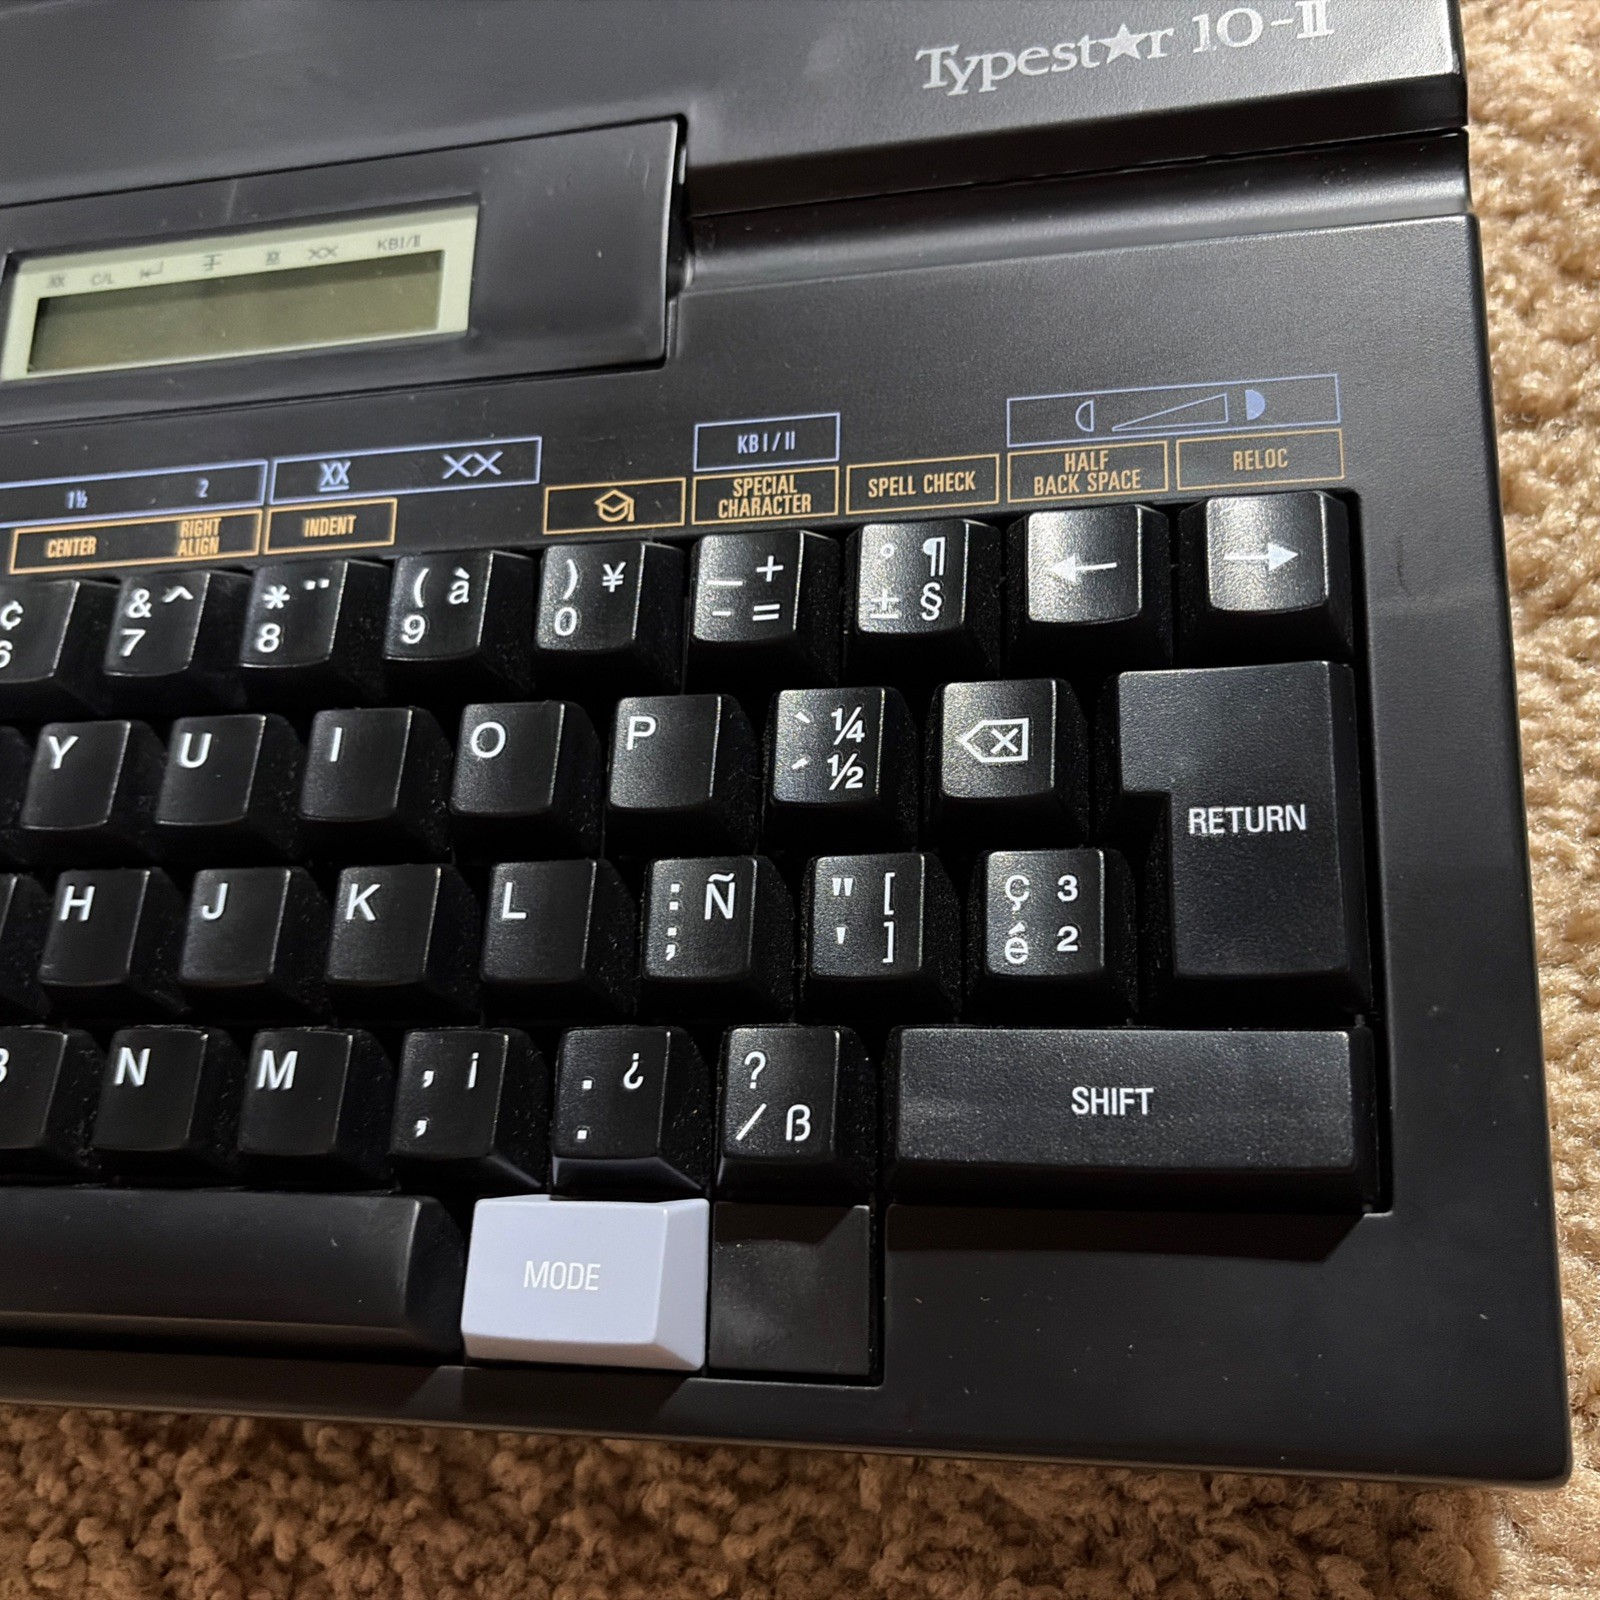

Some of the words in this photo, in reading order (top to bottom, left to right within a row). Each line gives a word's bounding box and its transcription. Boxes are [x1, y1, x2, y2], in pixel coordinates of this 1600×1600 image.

[1064, 450, 1110, 474] HALF
[1232, 447, 1290, 472] RELOC
[732, 474, 798, 498] SPECIAL
[867, 475, 917, 498] SPELL
[923, 470, 977, 494] CHECK
[1033, 474, 1081, 496] BACK
[1087, 468, 1142, 493] SPACE
[718, 493, 812, 519] CHARACTER
[177, 517, 222, 539] RIGHT
[303, 515, 357, 538] INDENT
[46, 536, 97, 558] CENTER
[176, 535, 220, 557] ALIGN
[602, 561, 628, 593] ¥
[756, 556, 784, 581] +
[126, 587, 154, 619] &
[412, 568, 429, 608] (
[919, 581, 944, 622] §
[751, 603, 781, 622] =
[119, 627, 147, 658] 7
[256, 623, 283, 655] 8
[401, 614, 427, 645] 9
[625, 714, 657, 751] P
[48, 734, 79, 770] Y
[178, 731, 213, 769] U
[1188, 803, 1308, 837] RETURN
[59, 884, 95, 922] H
[201, 882, 229, 921] J
[344, 883, 381, 922] K
[500, 881, 528, 921] L
[703, 872, 737, 921] Ñ
[883, 871, 896, 916] [
[1056, 875, 1079, 902] 3
[882, 921, 895, 964] ]
[1056, 925, 1079, 952] 2
[113, 1046, 151, 1087] N
[255, 1049, 299, 1091] M
[622, 1052, 644, 1090] ¿
[743, 1050, 767, 1090] ?
[1070, 1086, 1155, 1117] SHIFT
[735, 1102, 768, 1142] /
[523, 1258, 601, 1294] MODE
